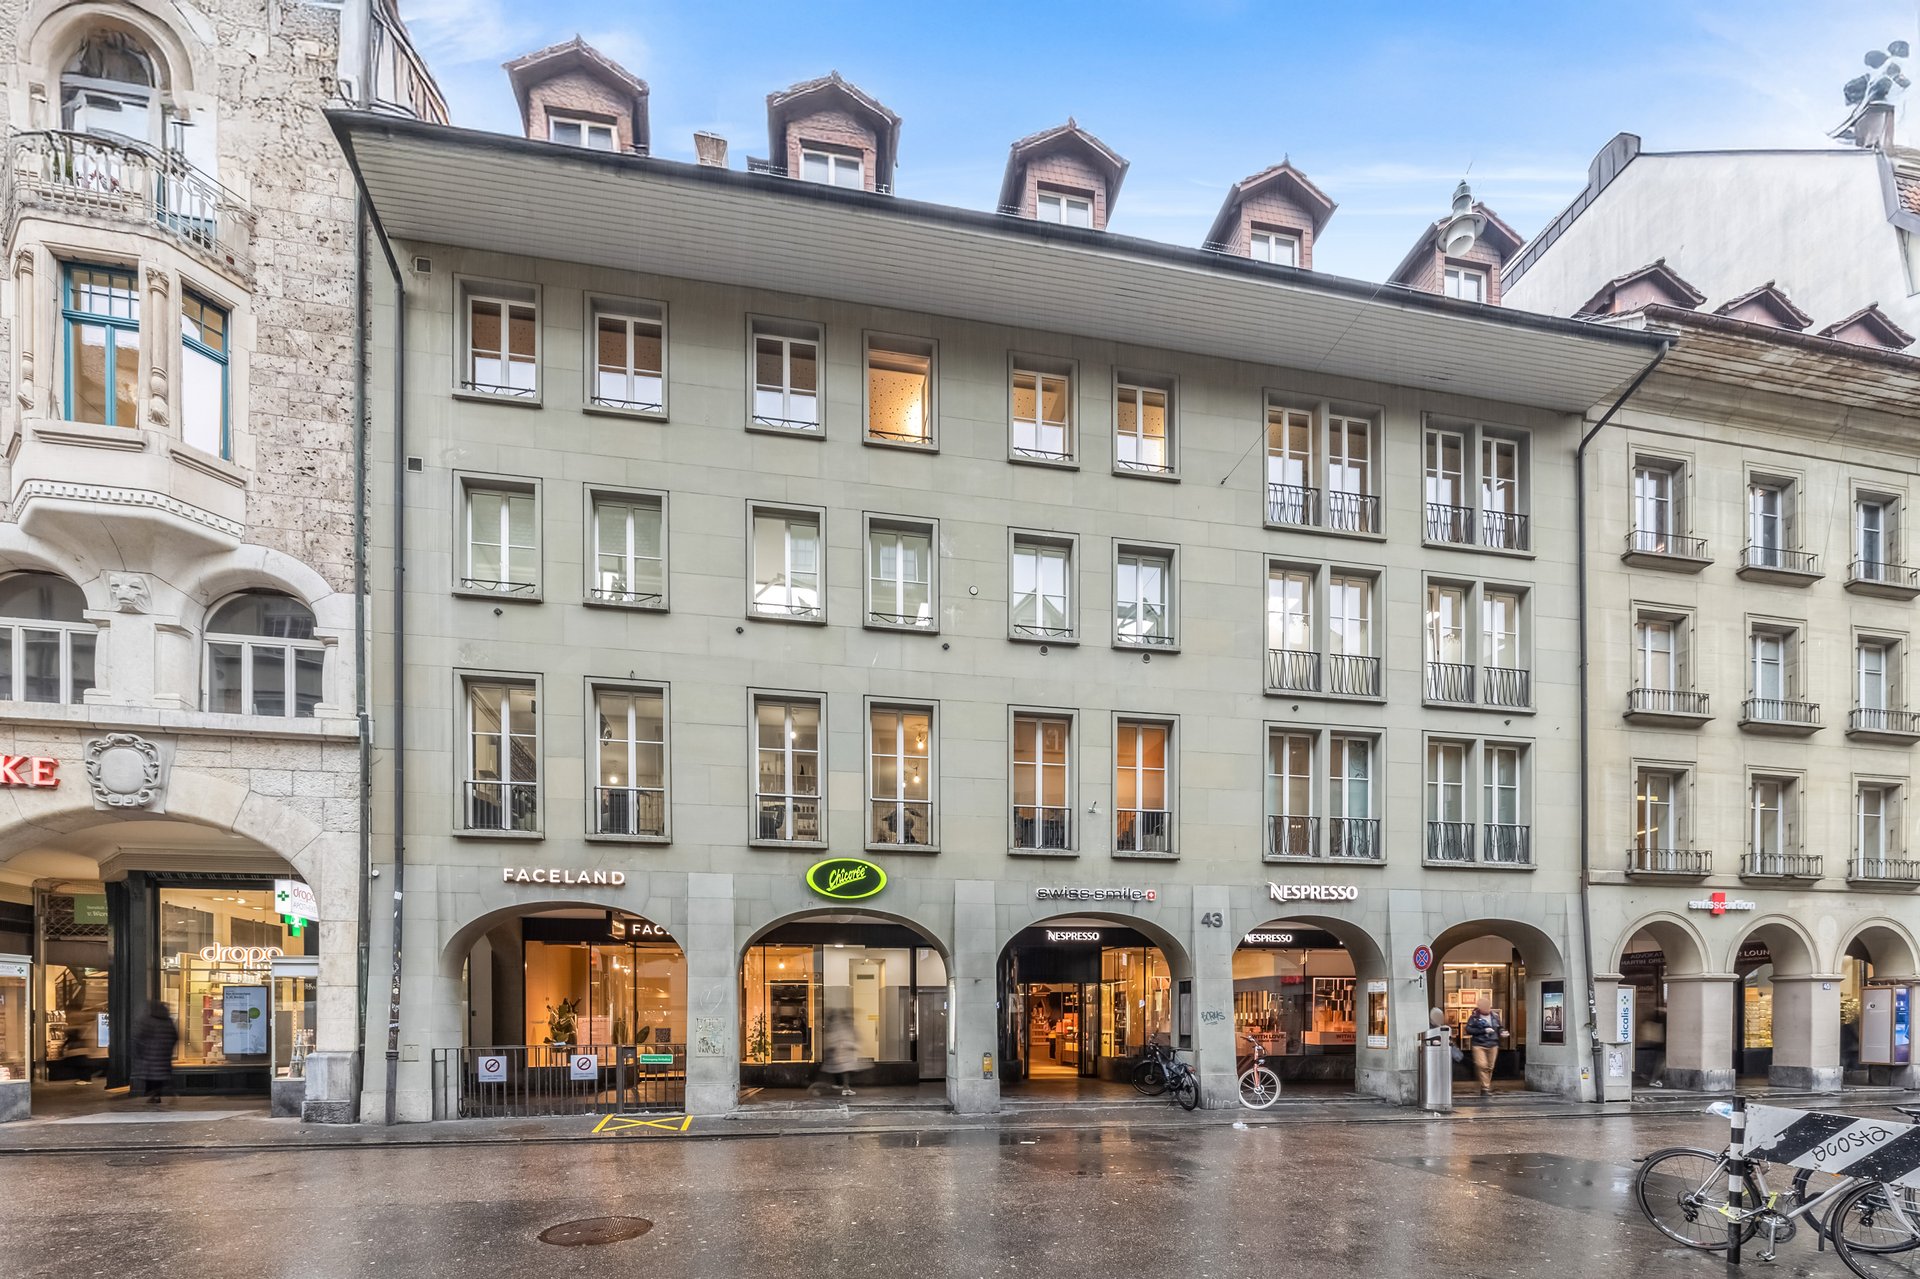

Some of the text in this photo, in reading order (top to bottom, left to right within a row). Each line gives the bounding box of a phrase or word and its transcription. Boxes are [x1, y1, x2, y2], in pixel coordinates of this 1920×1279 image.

[503, 868, 625, 885] FACELAND
[1267, 881, 1359, 902] NESPRESSO
[1201, 912, 1224, 929] 43
[632, 924, 670, 935] FAC
[1046, 929, 1100, 942] NESPRESSO
[1244, 933, 1293, 944] NESPRESSO
[1621, 1007, 1629, 1041] dicalis
